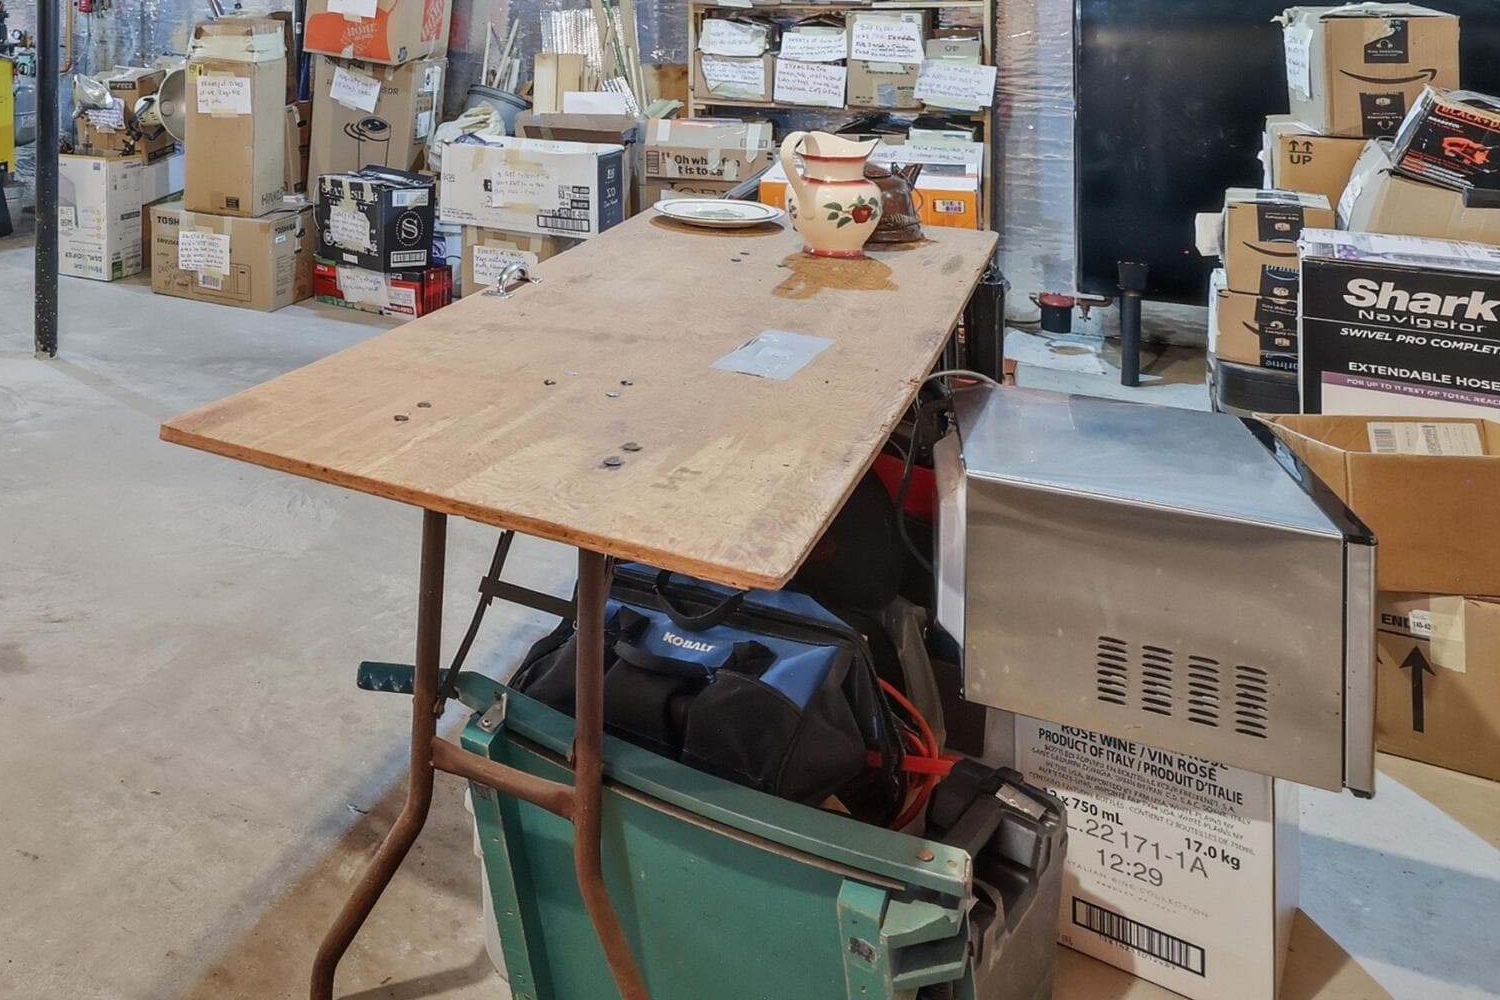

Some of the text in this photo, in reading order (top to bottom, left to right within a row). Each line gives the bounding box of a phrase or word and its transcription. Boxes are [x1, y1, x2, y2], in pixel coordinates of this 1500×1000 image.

[674, 154, 690, 165] Oh
[1289, 154, 1313, 165] UP
[1342, 277, 1500, 323] Shark
[1358, 309, 1487, 334] Navigator
[1340, 327, 1500, 355] SWIVEL PRO COMPLET
[1346, 378, 1365, 387] FOR
[1367, 380, 1379, 388] UP
[1381, 382, 1393, 391] TO
[1427, 389, 1441, 398] OF
[1443, 391, 1472, 402] TOTAL
[1348, 361, 1500, 392] EXTENDABLE HOSE
[662, 631, 717, 652] KOBALT
[1038, 727, 1088, 755] PRODUCT
[1089, 743, 1105, 759] OF
[1106, 749, 1135, 769] ITALY
[1143, 761, 1195, 788] PRODUIT
[1195, 779, 1245, 806] D'ITALIE
[1099, 733, 1137, 756] WINE
[1147, 748, 1176, 768] VIN
[1177, 758, 1218, 782] ROSÉ
[1061, 796, 1070, 807] x
[1071, 797, 1099, 817] 750
[1101, 809, 1124, 826] mL
[1096, 849, 1164, 888] 12:29
[1184, 837, 1242, 871] 17.0 kg
